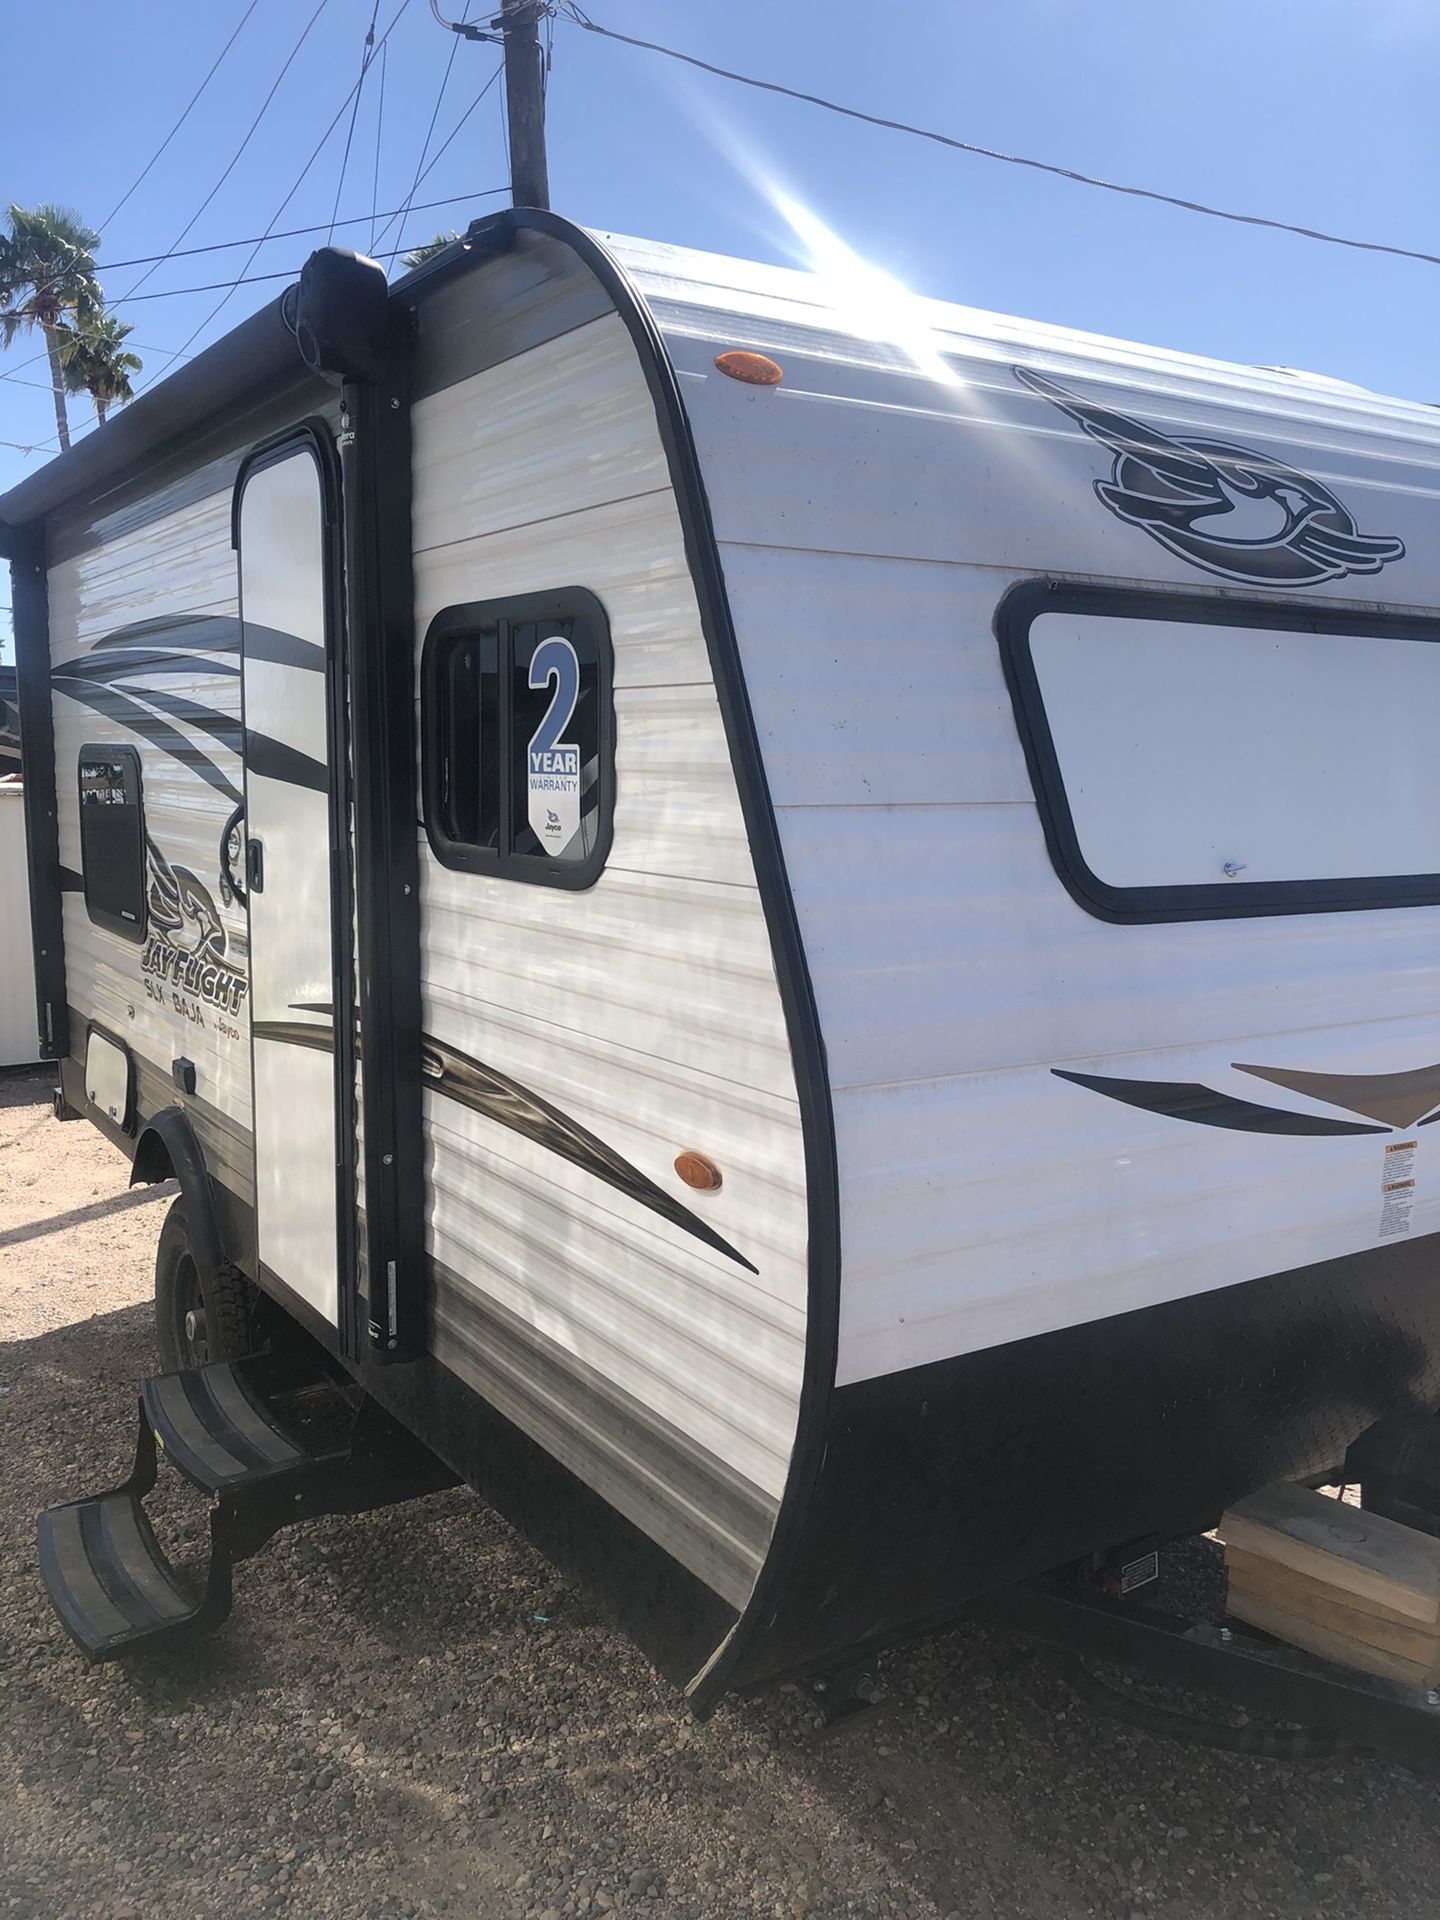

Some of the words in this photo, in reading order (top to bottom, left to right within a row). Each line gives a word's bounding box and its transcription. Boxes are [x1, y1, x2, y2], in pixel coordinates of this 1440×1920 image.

[528, 636, 580, 751] 2
[530, 752, 577, 773] YEAR
[530, 779, 578, 792] WARRANTY
[545, 823, 562, 832] Jayco
[171, 946, 250, 1017] FLIGHT
[144, 978, 166, 1006] SLX
[172, 992, 206, 1029] BAJA
